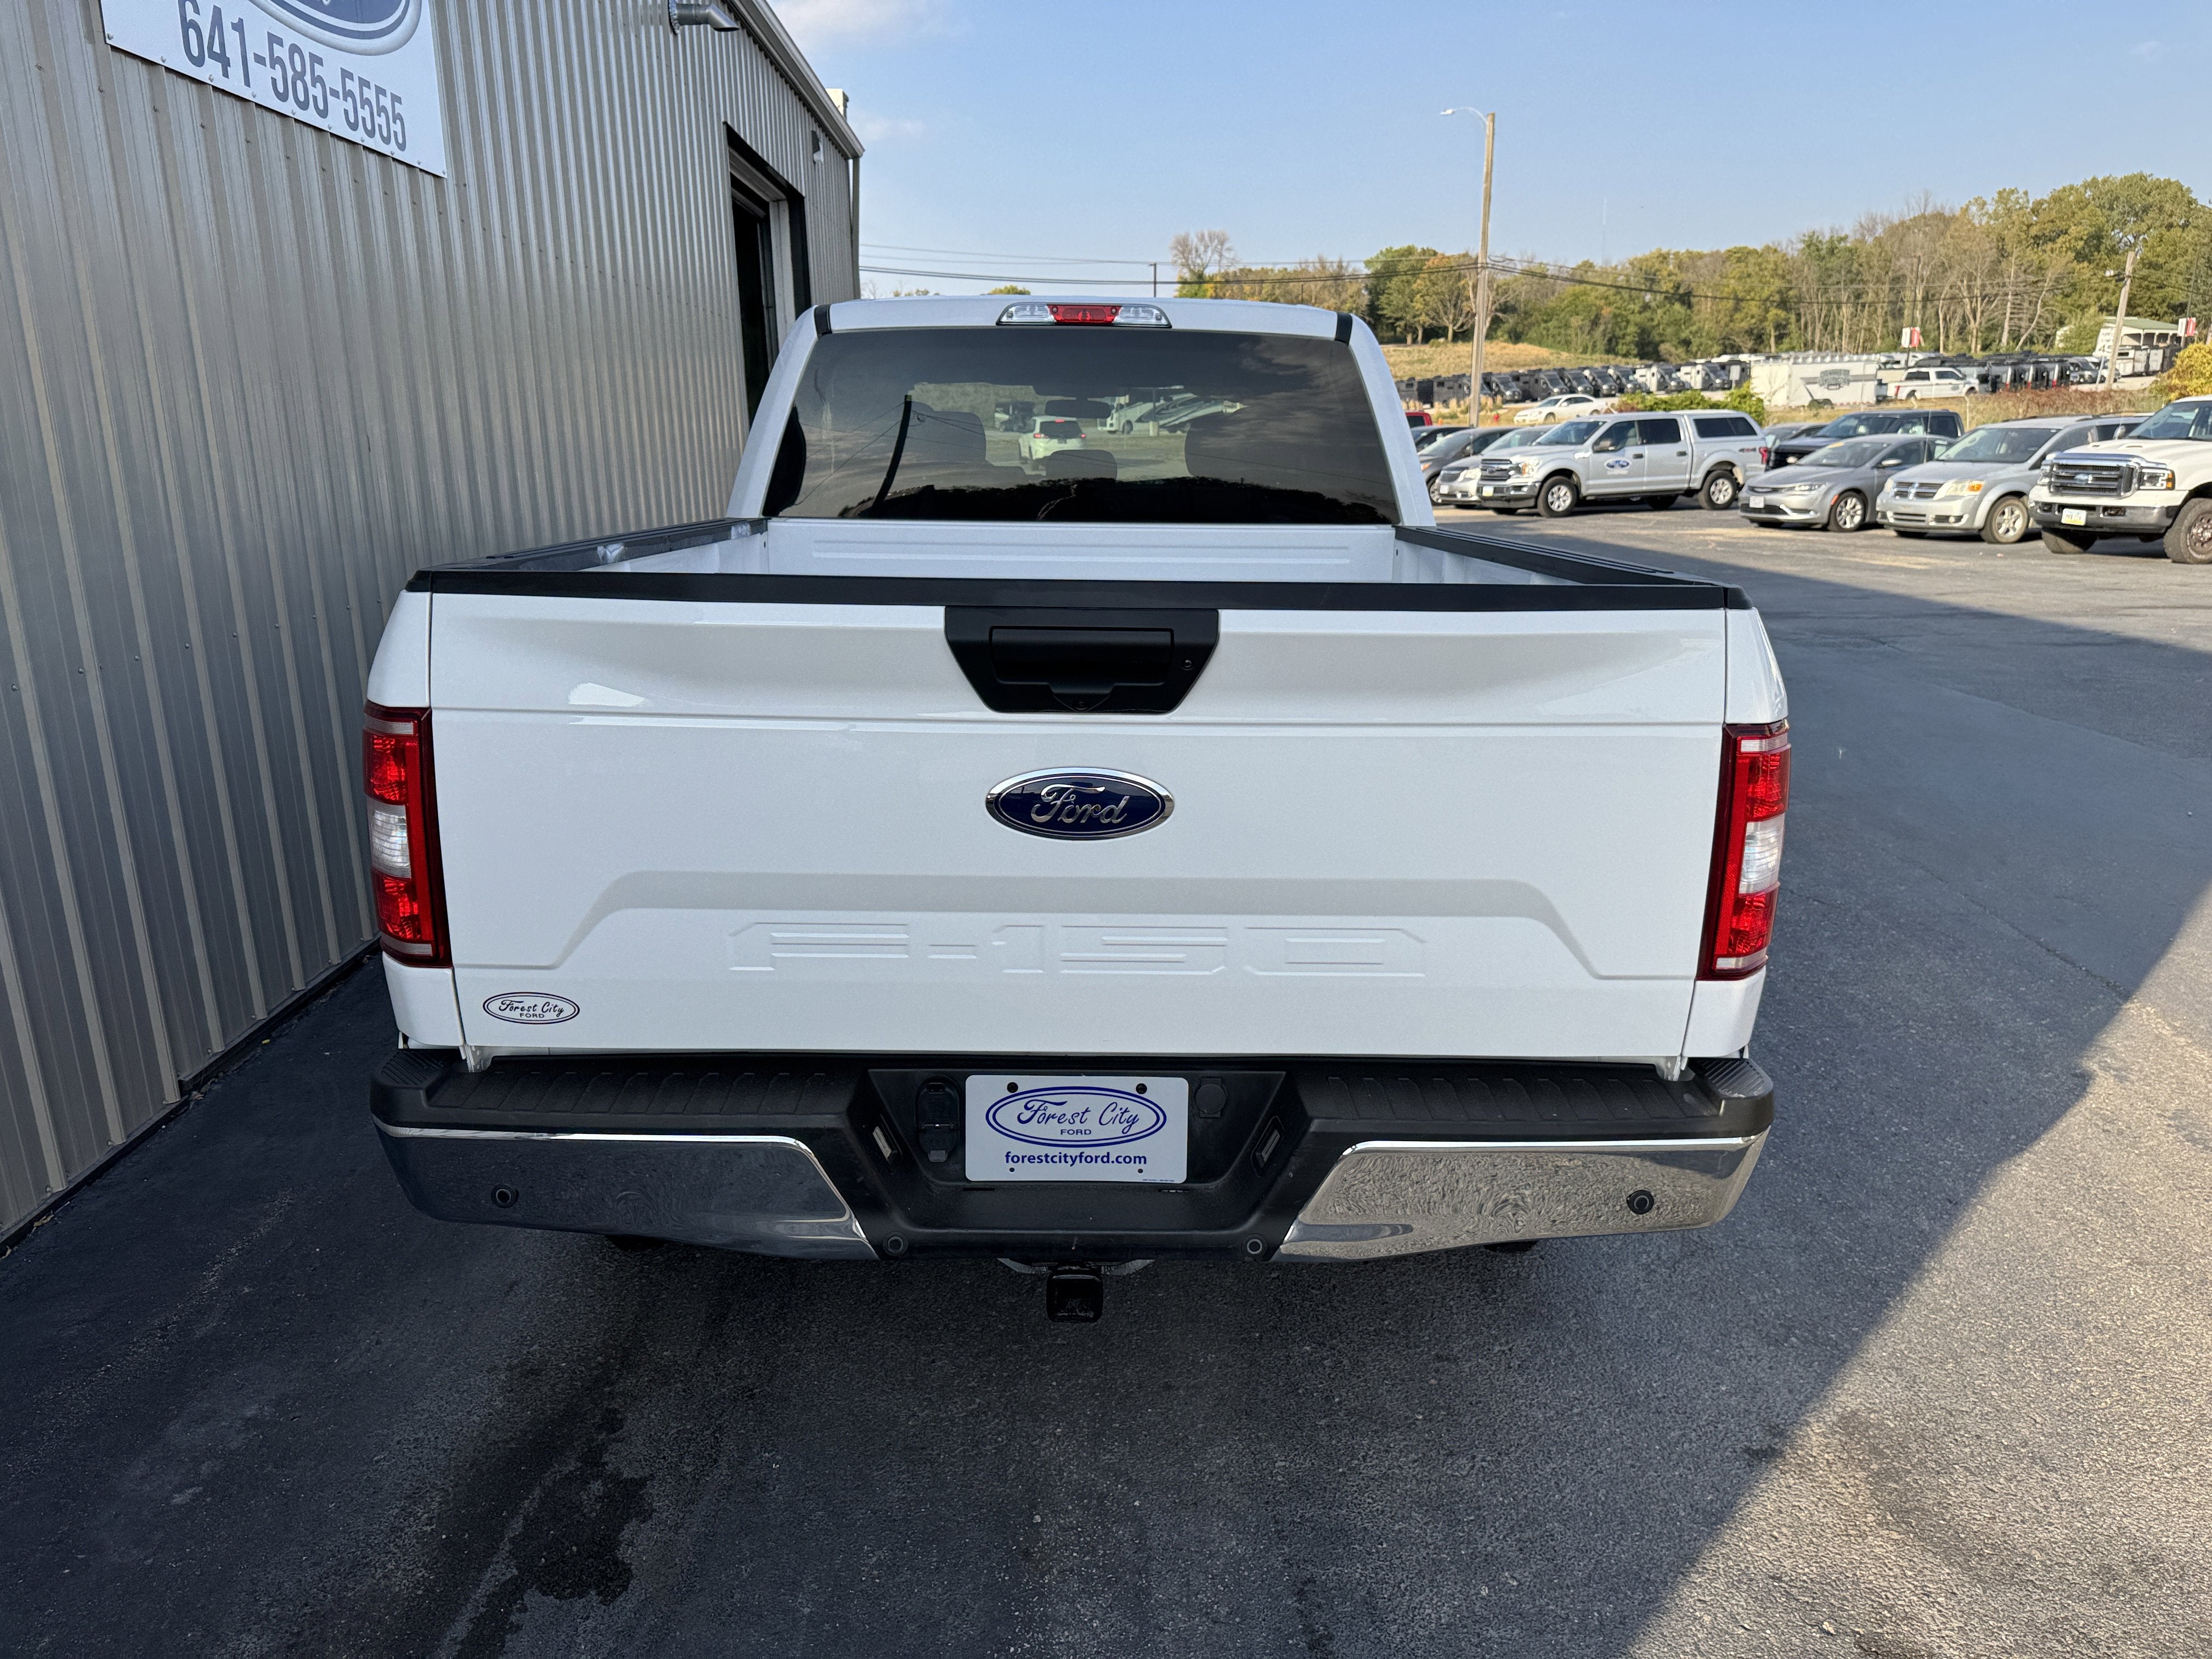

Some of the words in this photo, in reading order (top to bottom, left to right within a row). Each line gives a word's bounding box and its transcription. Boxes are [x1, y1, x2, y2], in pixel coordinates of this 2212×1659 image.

[178, 0, 407, 152] 641-585-5555
[1030, 783, 1130, 823] Ford
[729, 921, 1427, 977] F-150
[498, 999, 538, 1012] Forest
[541, 1001, 565, 1017] City
[1017, 1099, 1091, 1125] Forest
[1098, 1102, 1139, 1134] City
[1005, 1151, 1147, 1167] forestcityford.com
